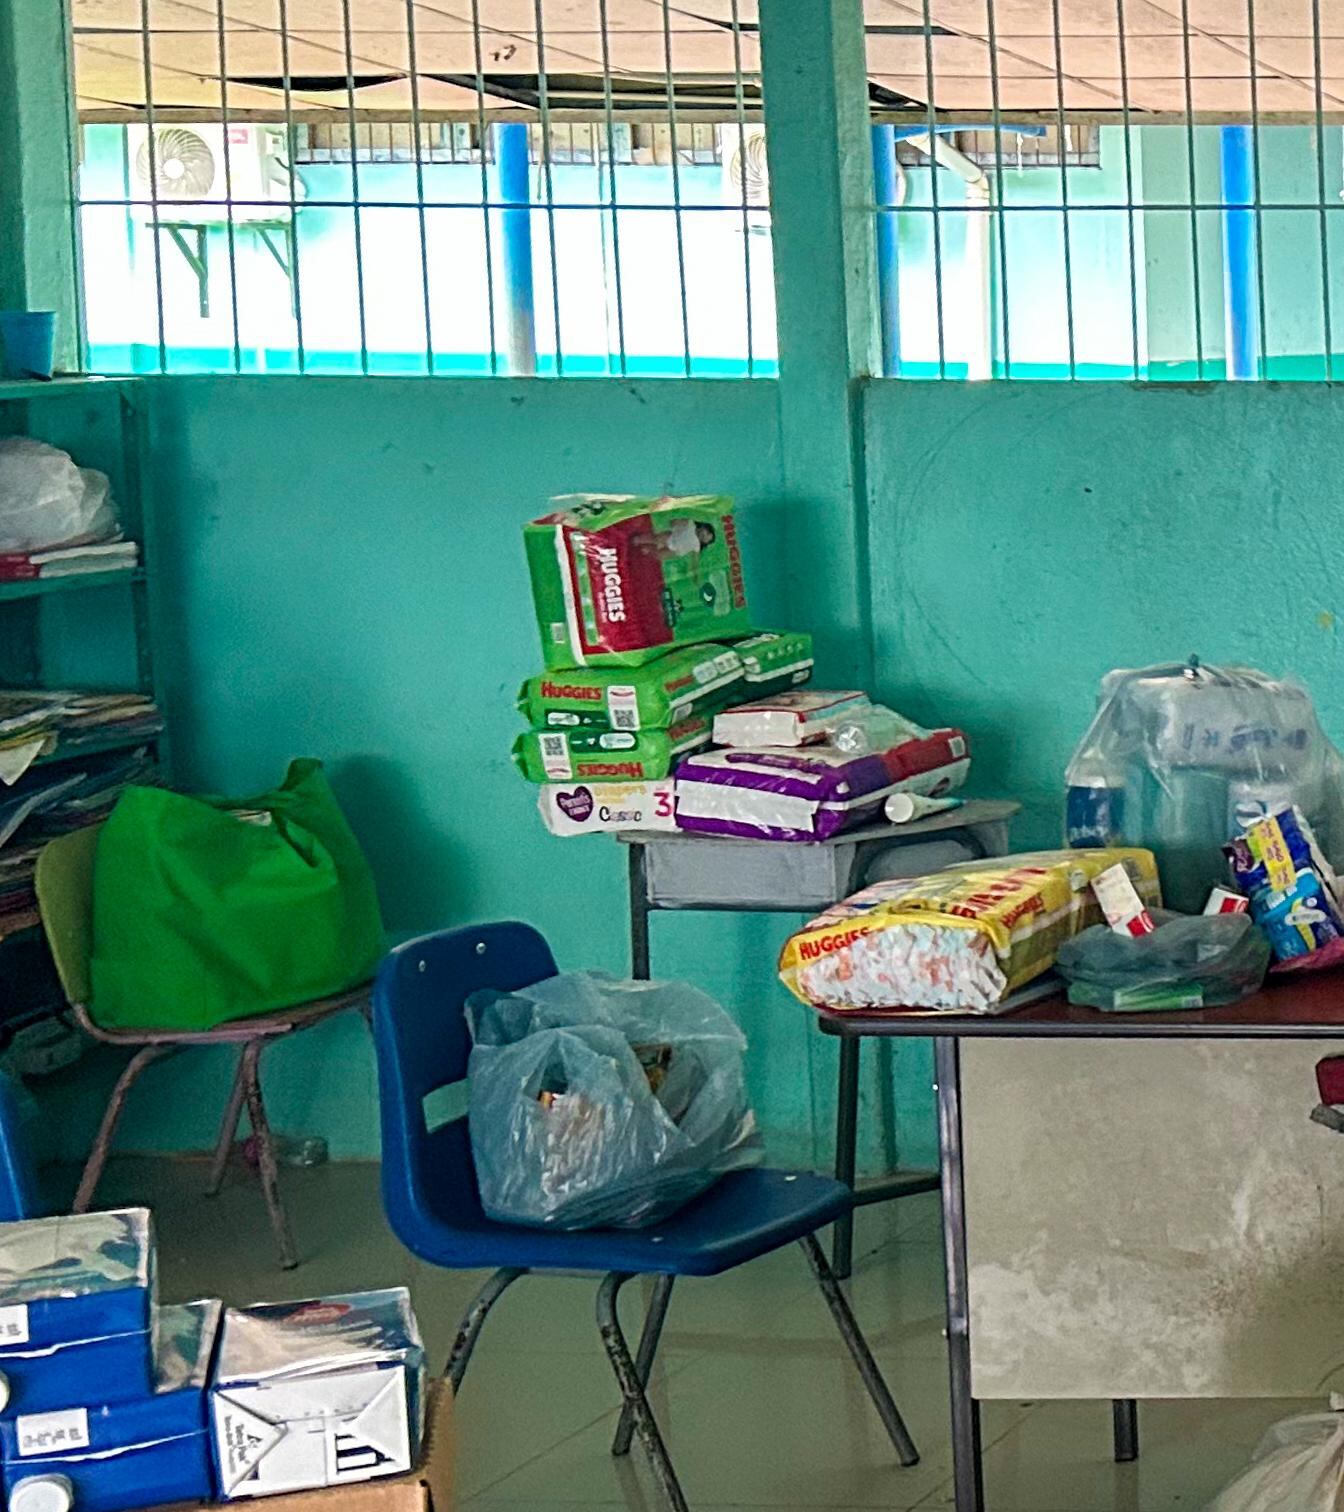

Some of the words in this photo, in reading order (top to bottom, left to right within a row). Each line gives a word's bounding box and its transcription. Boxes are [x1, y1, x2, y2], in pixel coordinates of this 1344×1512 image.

[598, 547, 627, 623] HUGGIES
[540, 681, 602, 701] HUGGIES
[653, 791, 673, 817] 3
